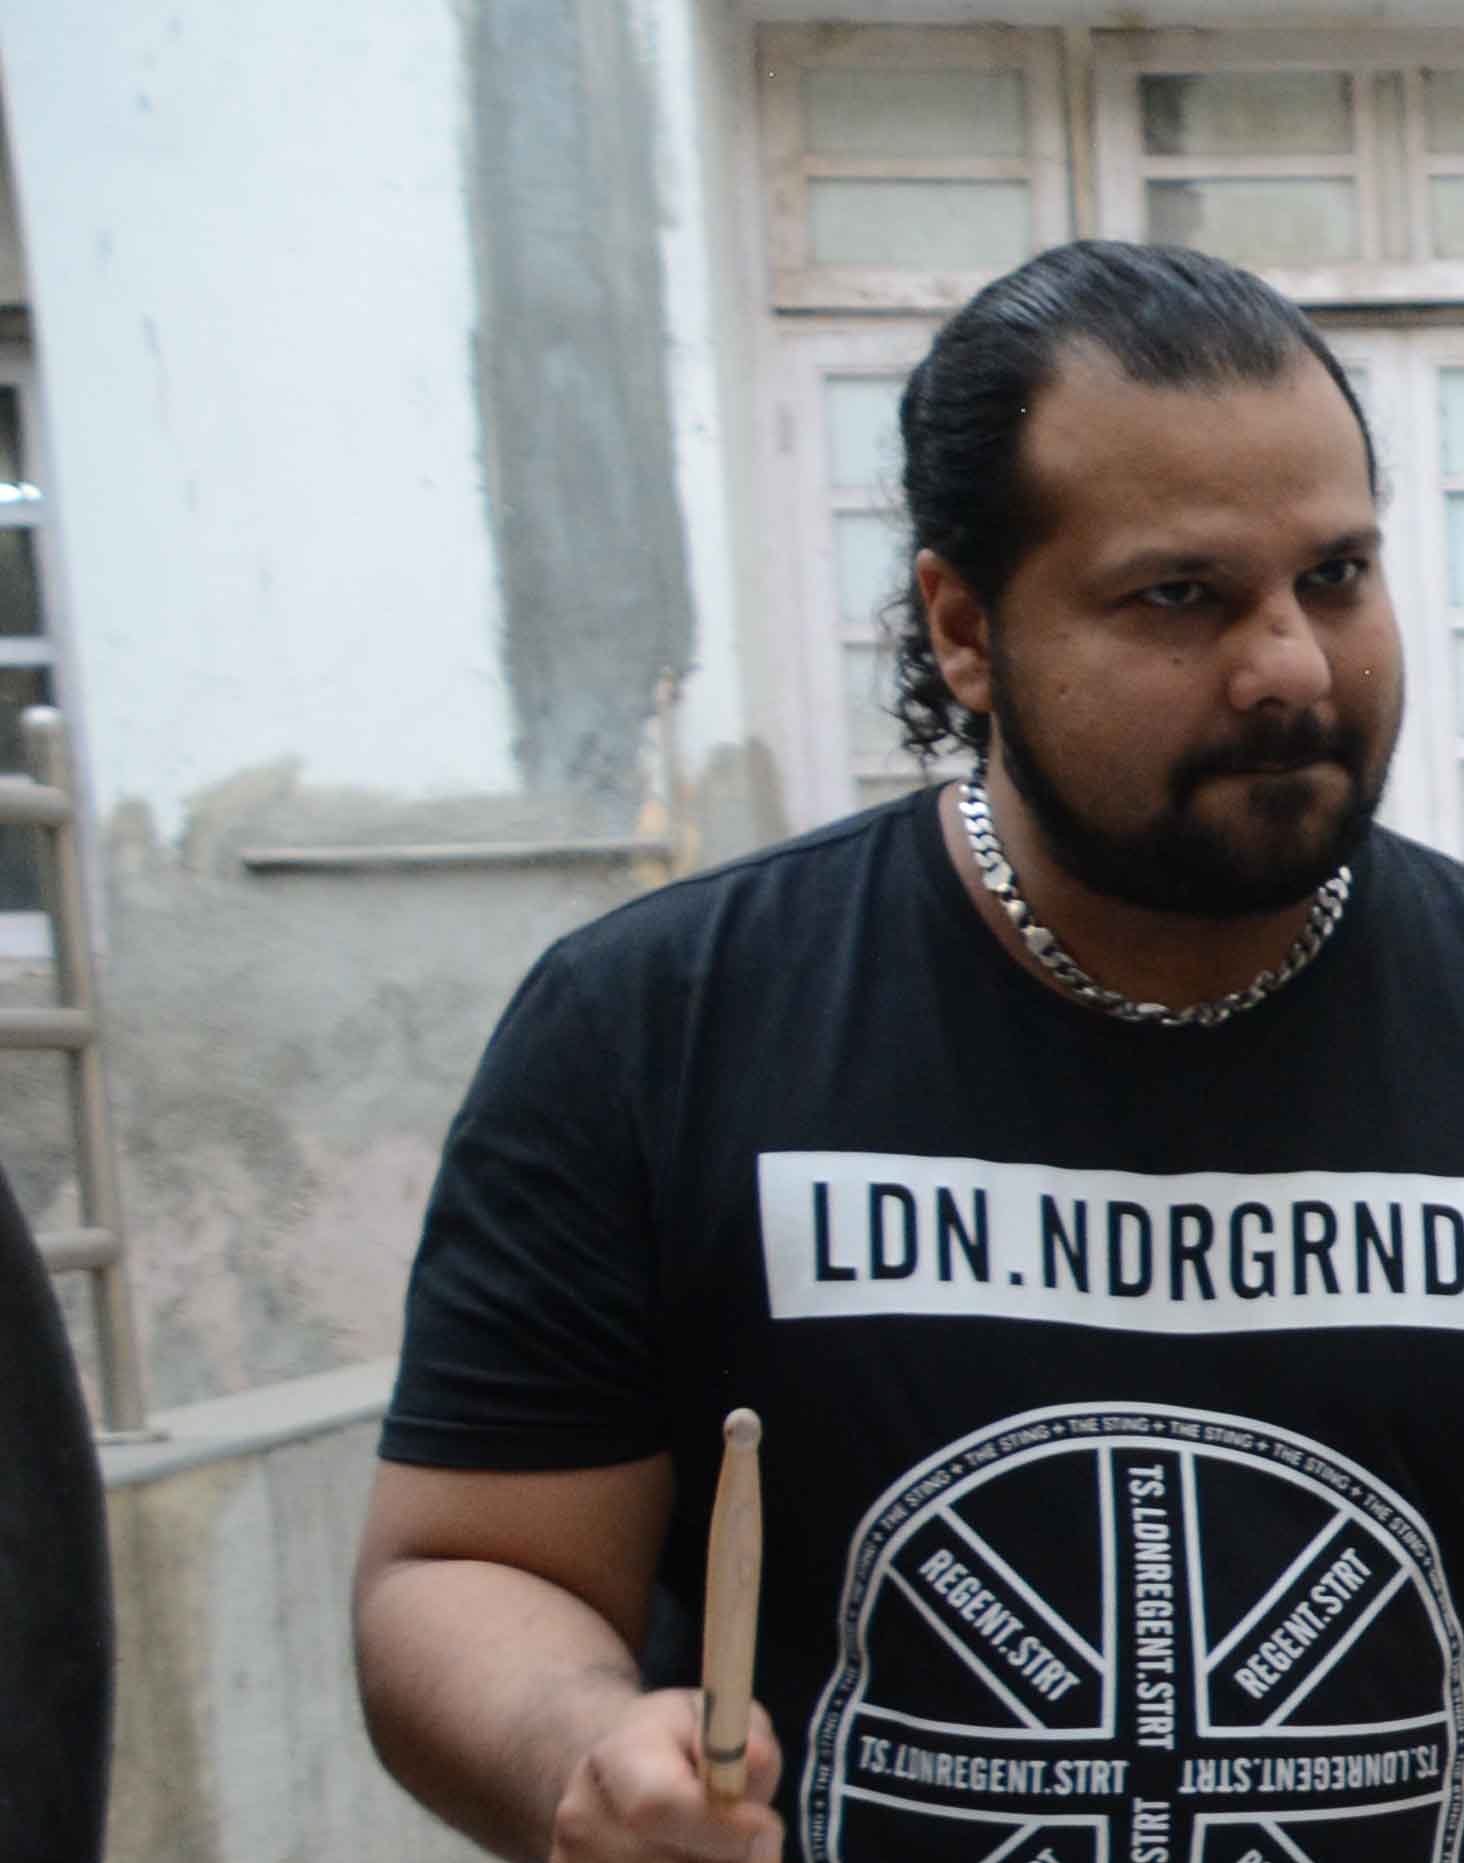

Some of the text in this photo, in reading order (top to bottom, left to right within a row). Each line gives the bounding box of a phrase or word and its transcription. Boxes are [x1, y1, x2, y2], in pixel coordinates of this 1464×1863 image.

[1068, 1415, 1150, 1433] THE STING
[1168, 1420, 1254, 1450] THE STING
[917, 1548, 1081, 1702] REGENT.STRT
[1232, 1546, 1373, 1701] REGENT.STRT
